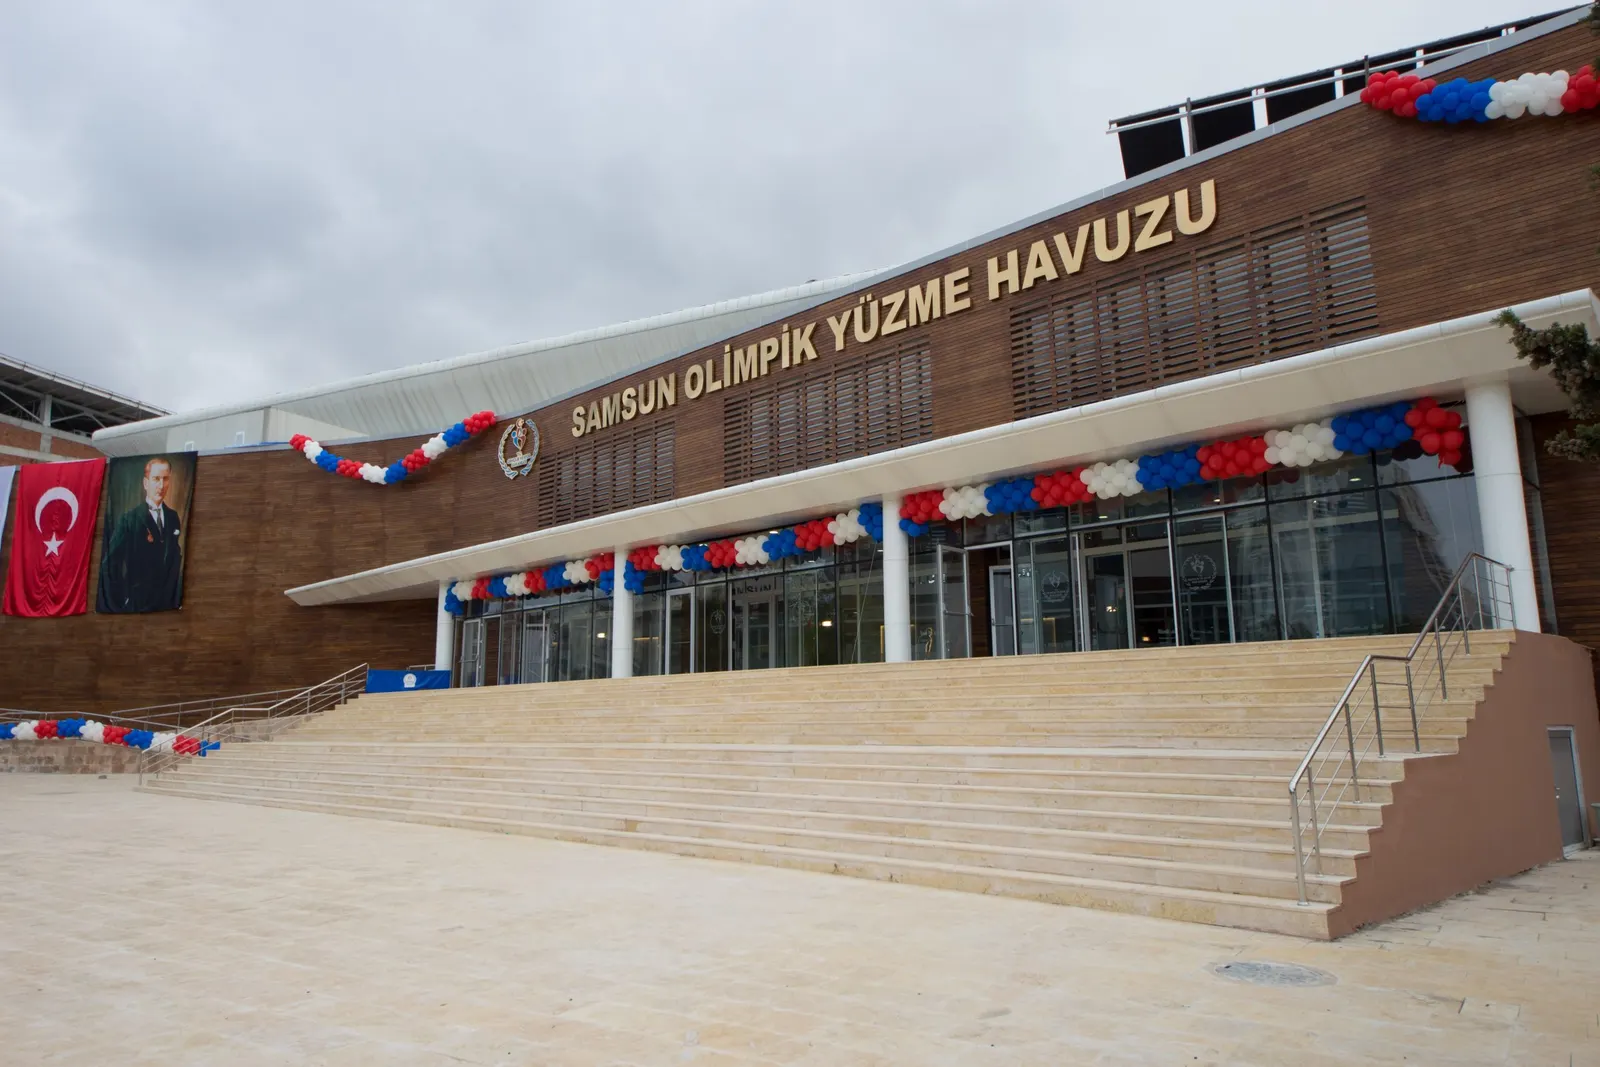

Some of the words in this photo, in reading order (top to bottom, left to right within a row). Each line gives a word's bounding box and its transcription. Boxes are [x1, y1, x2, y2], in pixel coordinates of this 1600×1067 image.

[571, 373, 676, 438] SAMSUN
[684, 322, 818, 399] OLİMPİK
[827, 267, 972, 352] YÜZME
[987, 179, 1218, 301] HAVUZU
